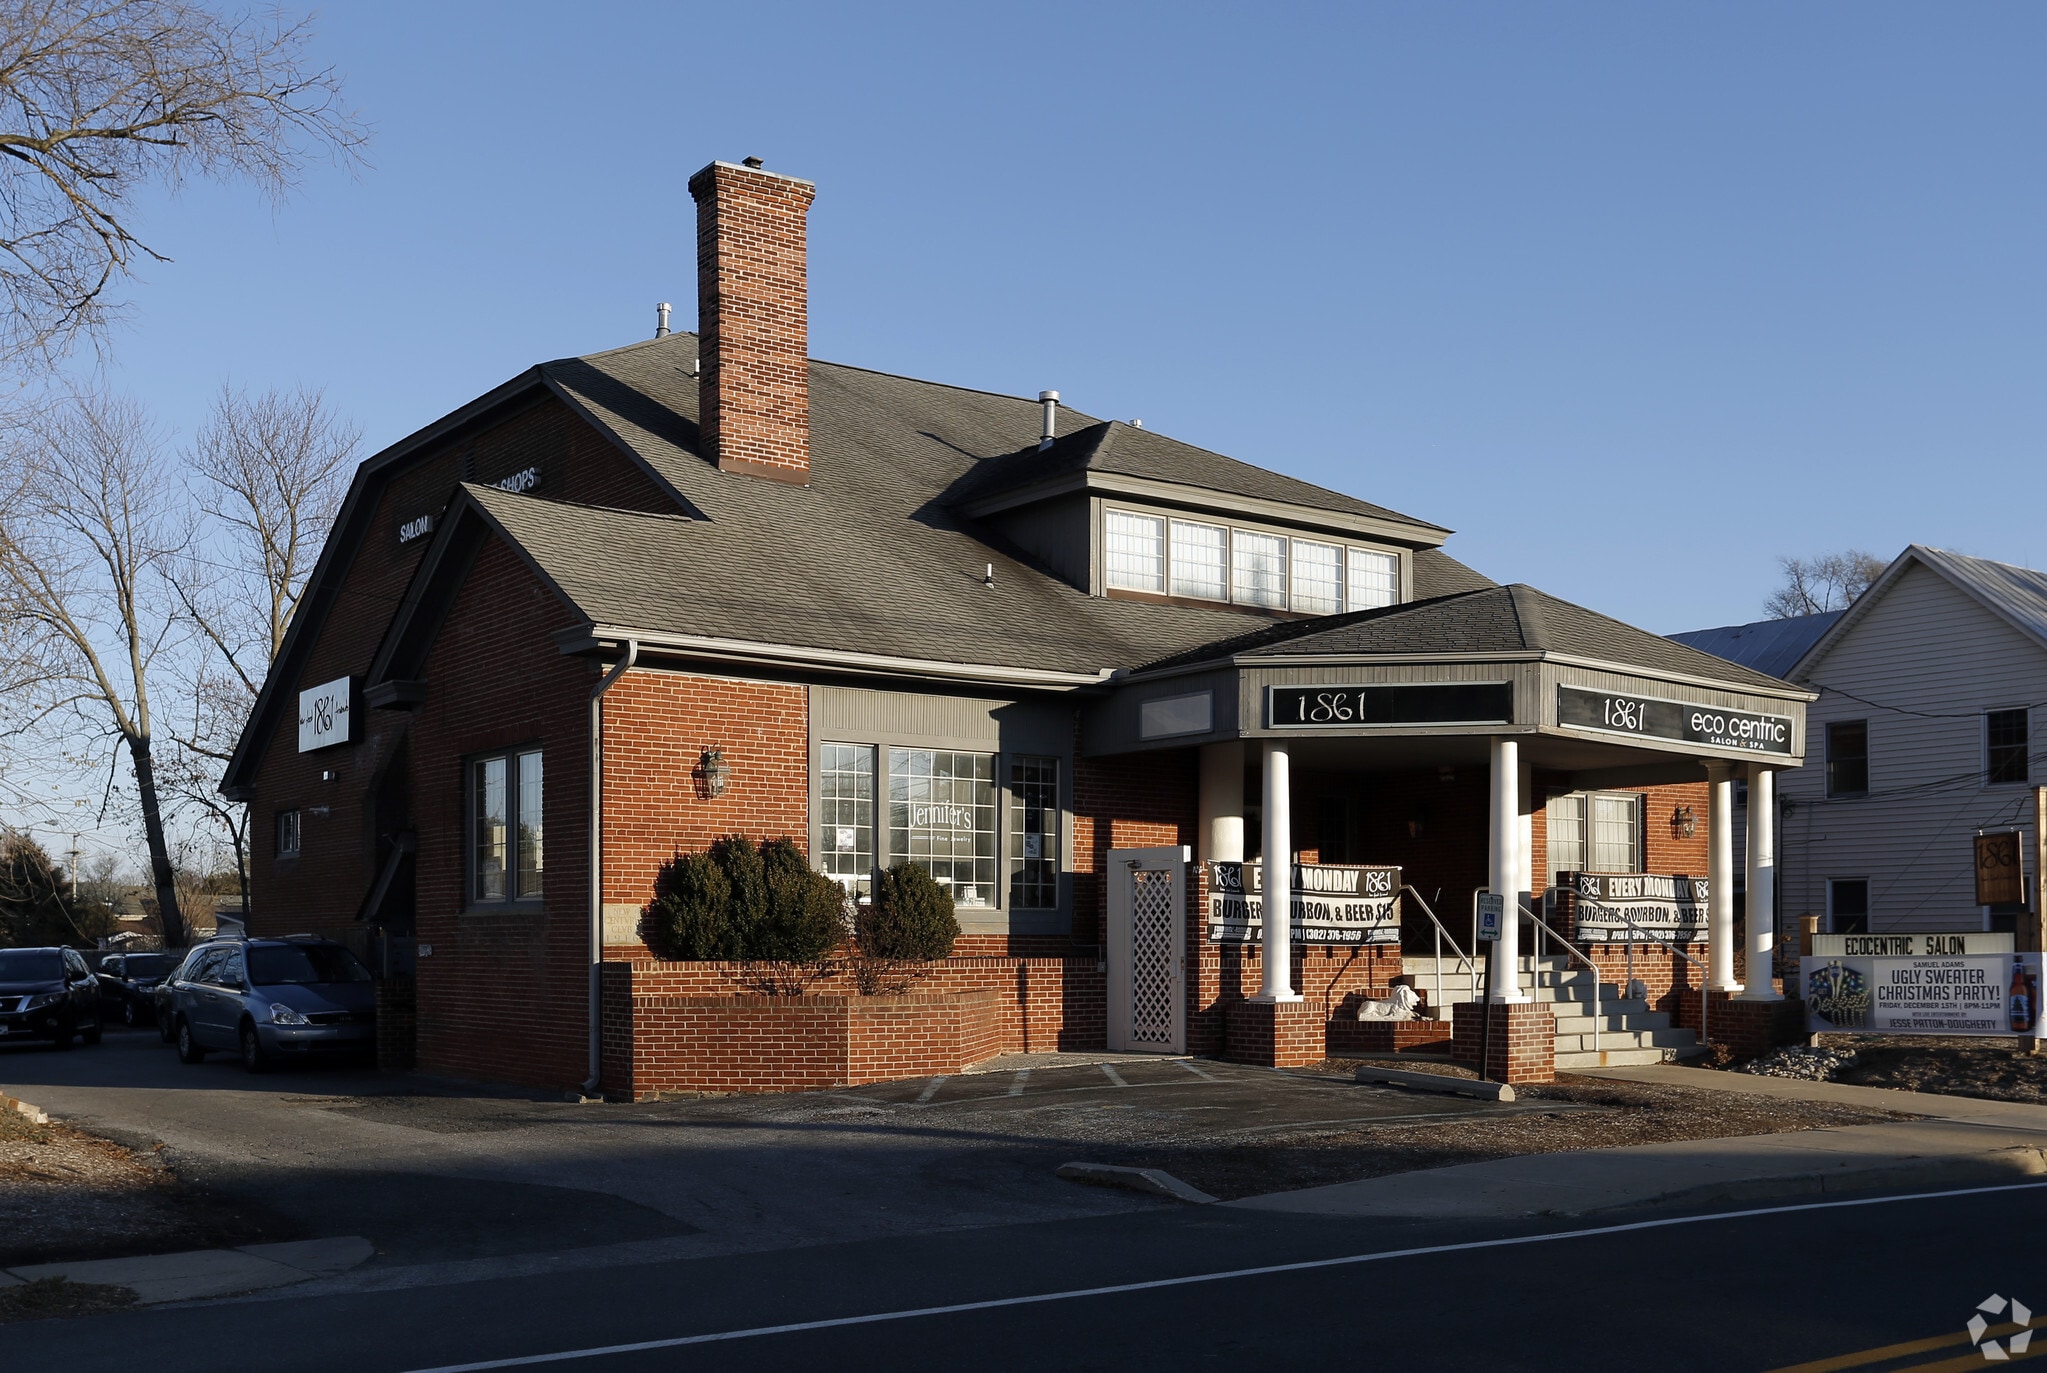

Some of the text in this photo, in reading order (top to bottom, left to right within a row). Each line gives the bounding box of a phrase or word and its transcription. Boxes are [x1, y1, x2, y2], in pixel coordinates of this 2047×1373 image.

[501, 466, 535, 492] SHOPS
[399, 515, 428, 543] SALON
[314, 694, 335, 735] 1861
[1298, 692, 1366, 721] 1861
[1604, 698, 1645, 731] 1861
[1691, 712, 1785, 743] eco centric
[1710, 736, 1765, 750] SALON & SPA
[910, 799, 972, 829] Jennifer's
[1978, 840, 2018, 869] 1861
[1213, 864, 1242, 888] 1861
[1302, 868, 1359, 892] MONDAY
[1365, 871, 1392, 893] 1861
[1580, 876, 1601, 895] 1861
[1608, 877, 1690, 898] EVERY MONDAY
[605, 916, 636, 924] CENTVR
[613, 907, 630, 915] NEW
[1213, 898, 1394, 922] BURGER URBON, & BEER $15
[1673, 910, 1681, 923] &
[1681, 908, 1704, 923] BEER
[606, 934, 639, 942] 1916
[611, 925, 632, 933] CLVB
[1290, 928, 1302, 939] PM
[1845, 936, 1965, 955] ECOCENTRIC SALON
[1892, 969, 1985, 984] UGLY SWEATER
[1878, 985, 2001, 1001] CHRISTMAS PARTY!
[1889, 1018, 1996, 1029] JESSE PATTON-DOUGHERTY
